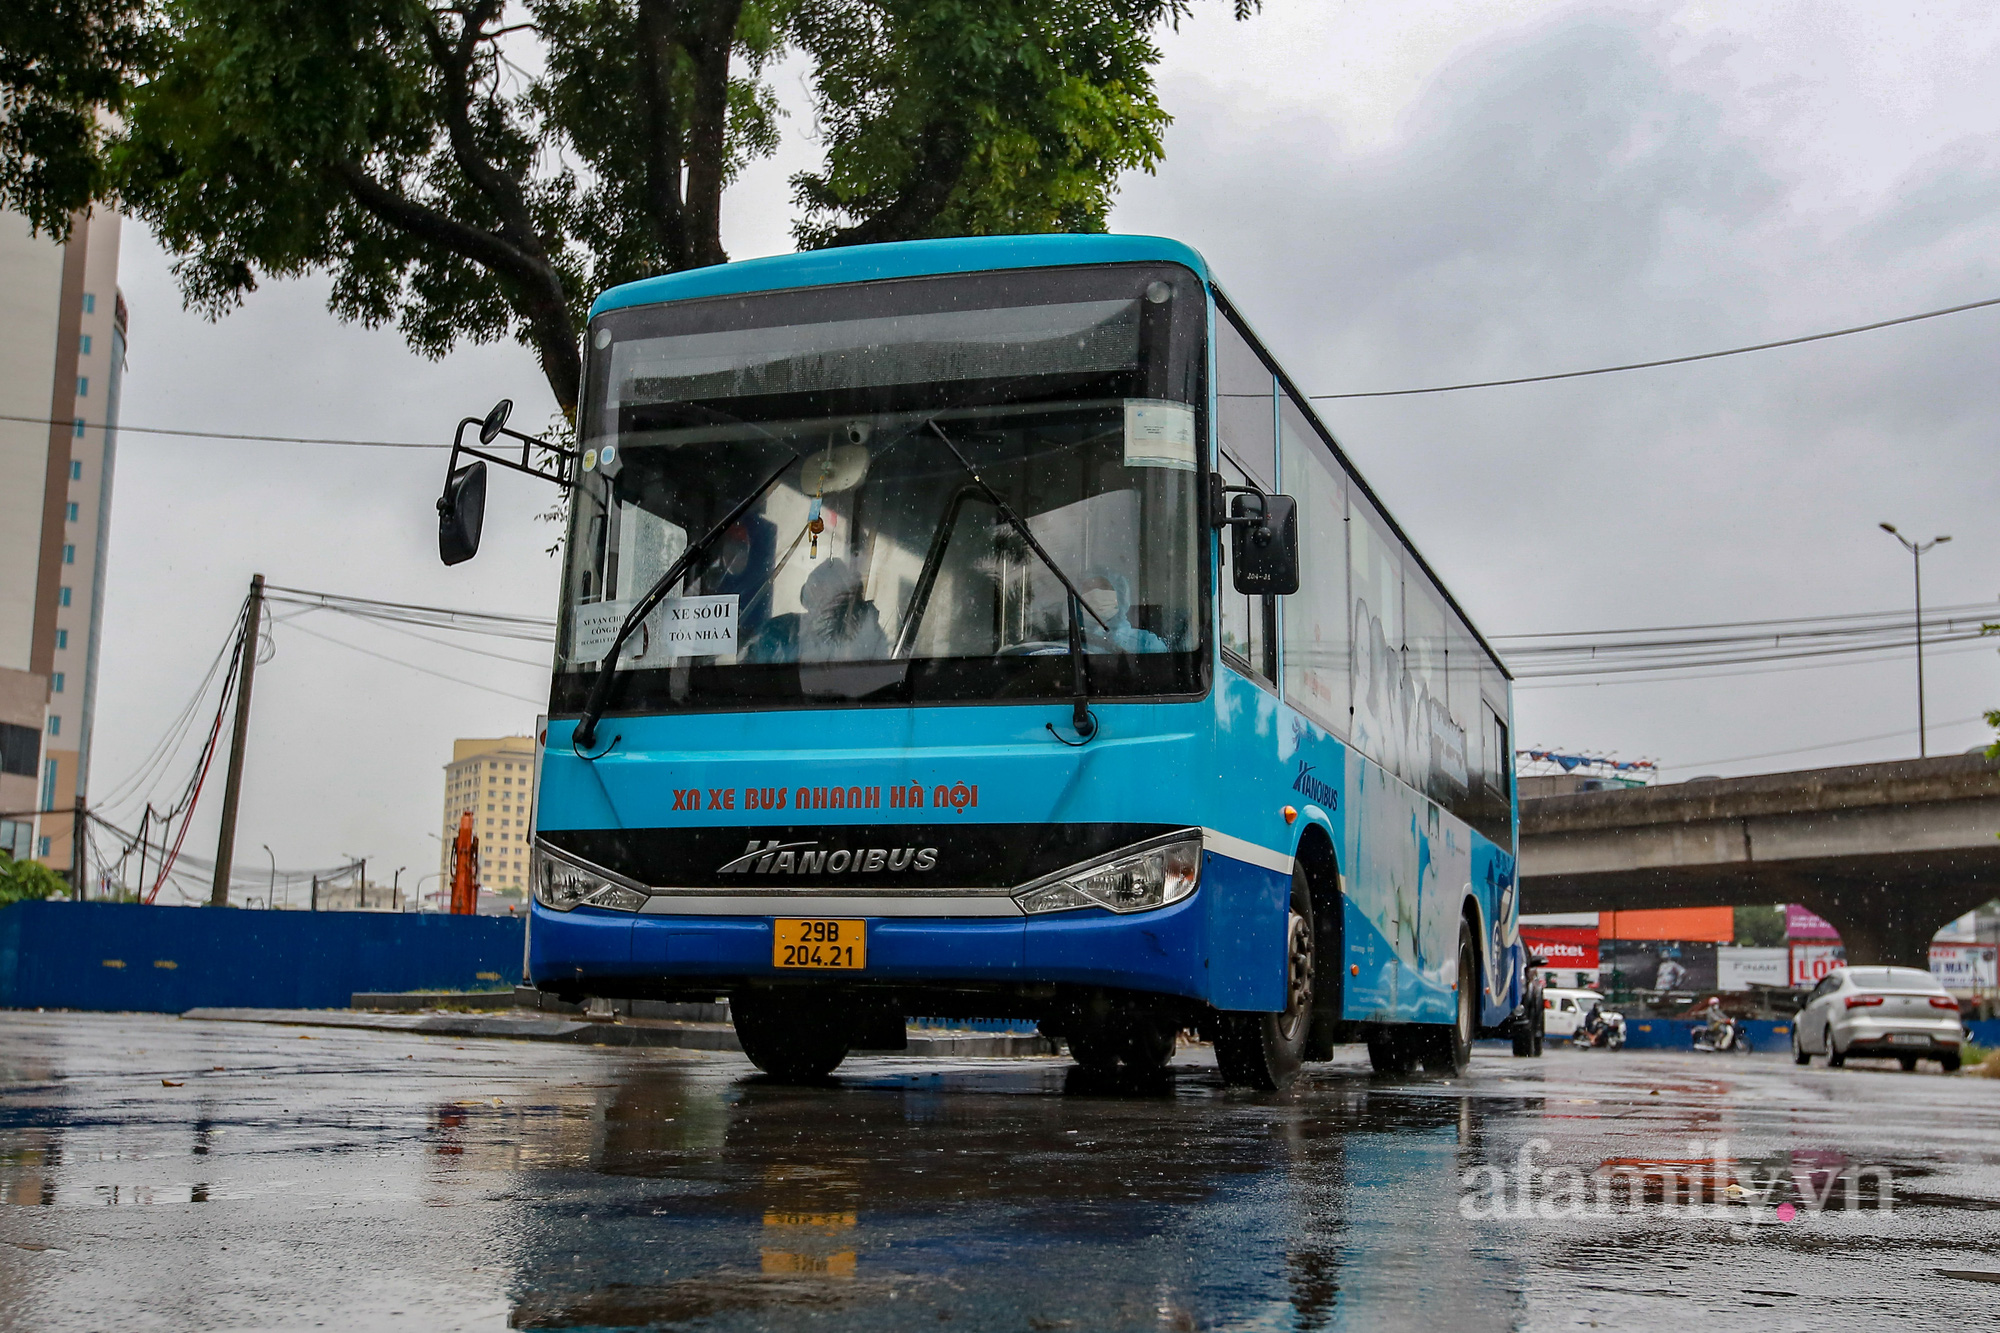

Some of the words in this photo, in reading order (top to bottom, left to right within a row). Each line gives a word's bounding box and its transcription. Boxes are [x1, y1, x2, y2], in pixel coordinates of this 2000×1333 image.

[671, 608, 690, 620] XE
[713, 602, 731, 618] 01
[695, 627, 719, 640] NHÀ
[721, 627, 732, 639] A
[1292, 759, 1338, 812] HANOIBUS
[671, 788, 701, 811] XN
[707, 788, 736, 810] XE
[744, 786, 788, 810] BUS
[795, 785, 881, 810] NHANH
[889, 779, 924, 808] HÀ
[933, 780, 978, 815] NỘI
[716, 839, 939, 876] HANOIBUS
[799, 921, 840, 943] 29B
[782, 945, 854, 967] 204.21
[1528, 942, 1585, 957] viettel
